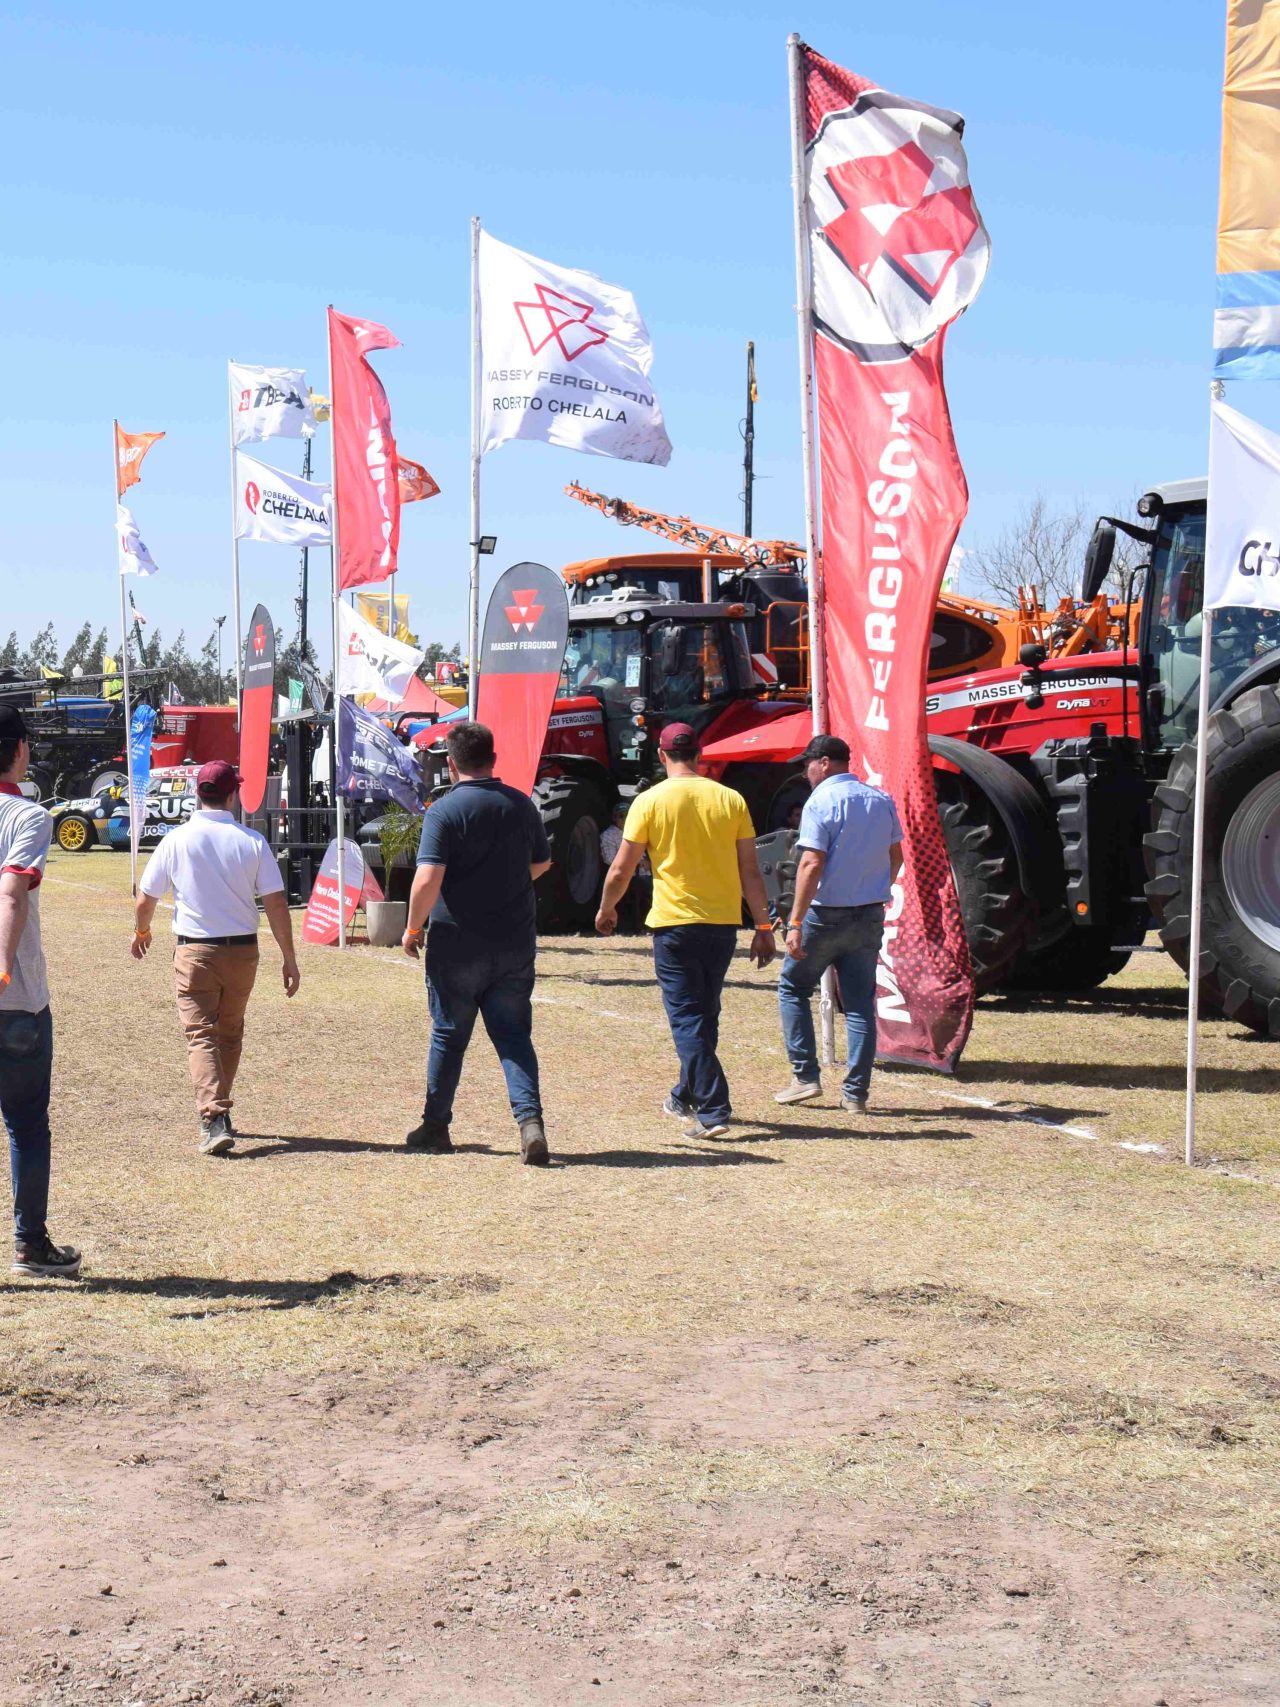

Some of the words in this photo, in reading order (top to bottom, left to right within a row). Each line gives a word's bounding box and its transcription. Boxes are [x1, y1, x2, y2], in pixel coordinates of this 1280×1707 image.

[548, 399, 628, 424] CHELALA
[262, 499, 329, 525] CHELALA
[864, 391, 918, 731] FERGUSON
[491, 641, 518, 651] MASSEY
[519, 640, 558, 650] FERGUSON
[969, 683, 1024, 702] MASSEY
[561, 714, 595, 726] FERGUSON
